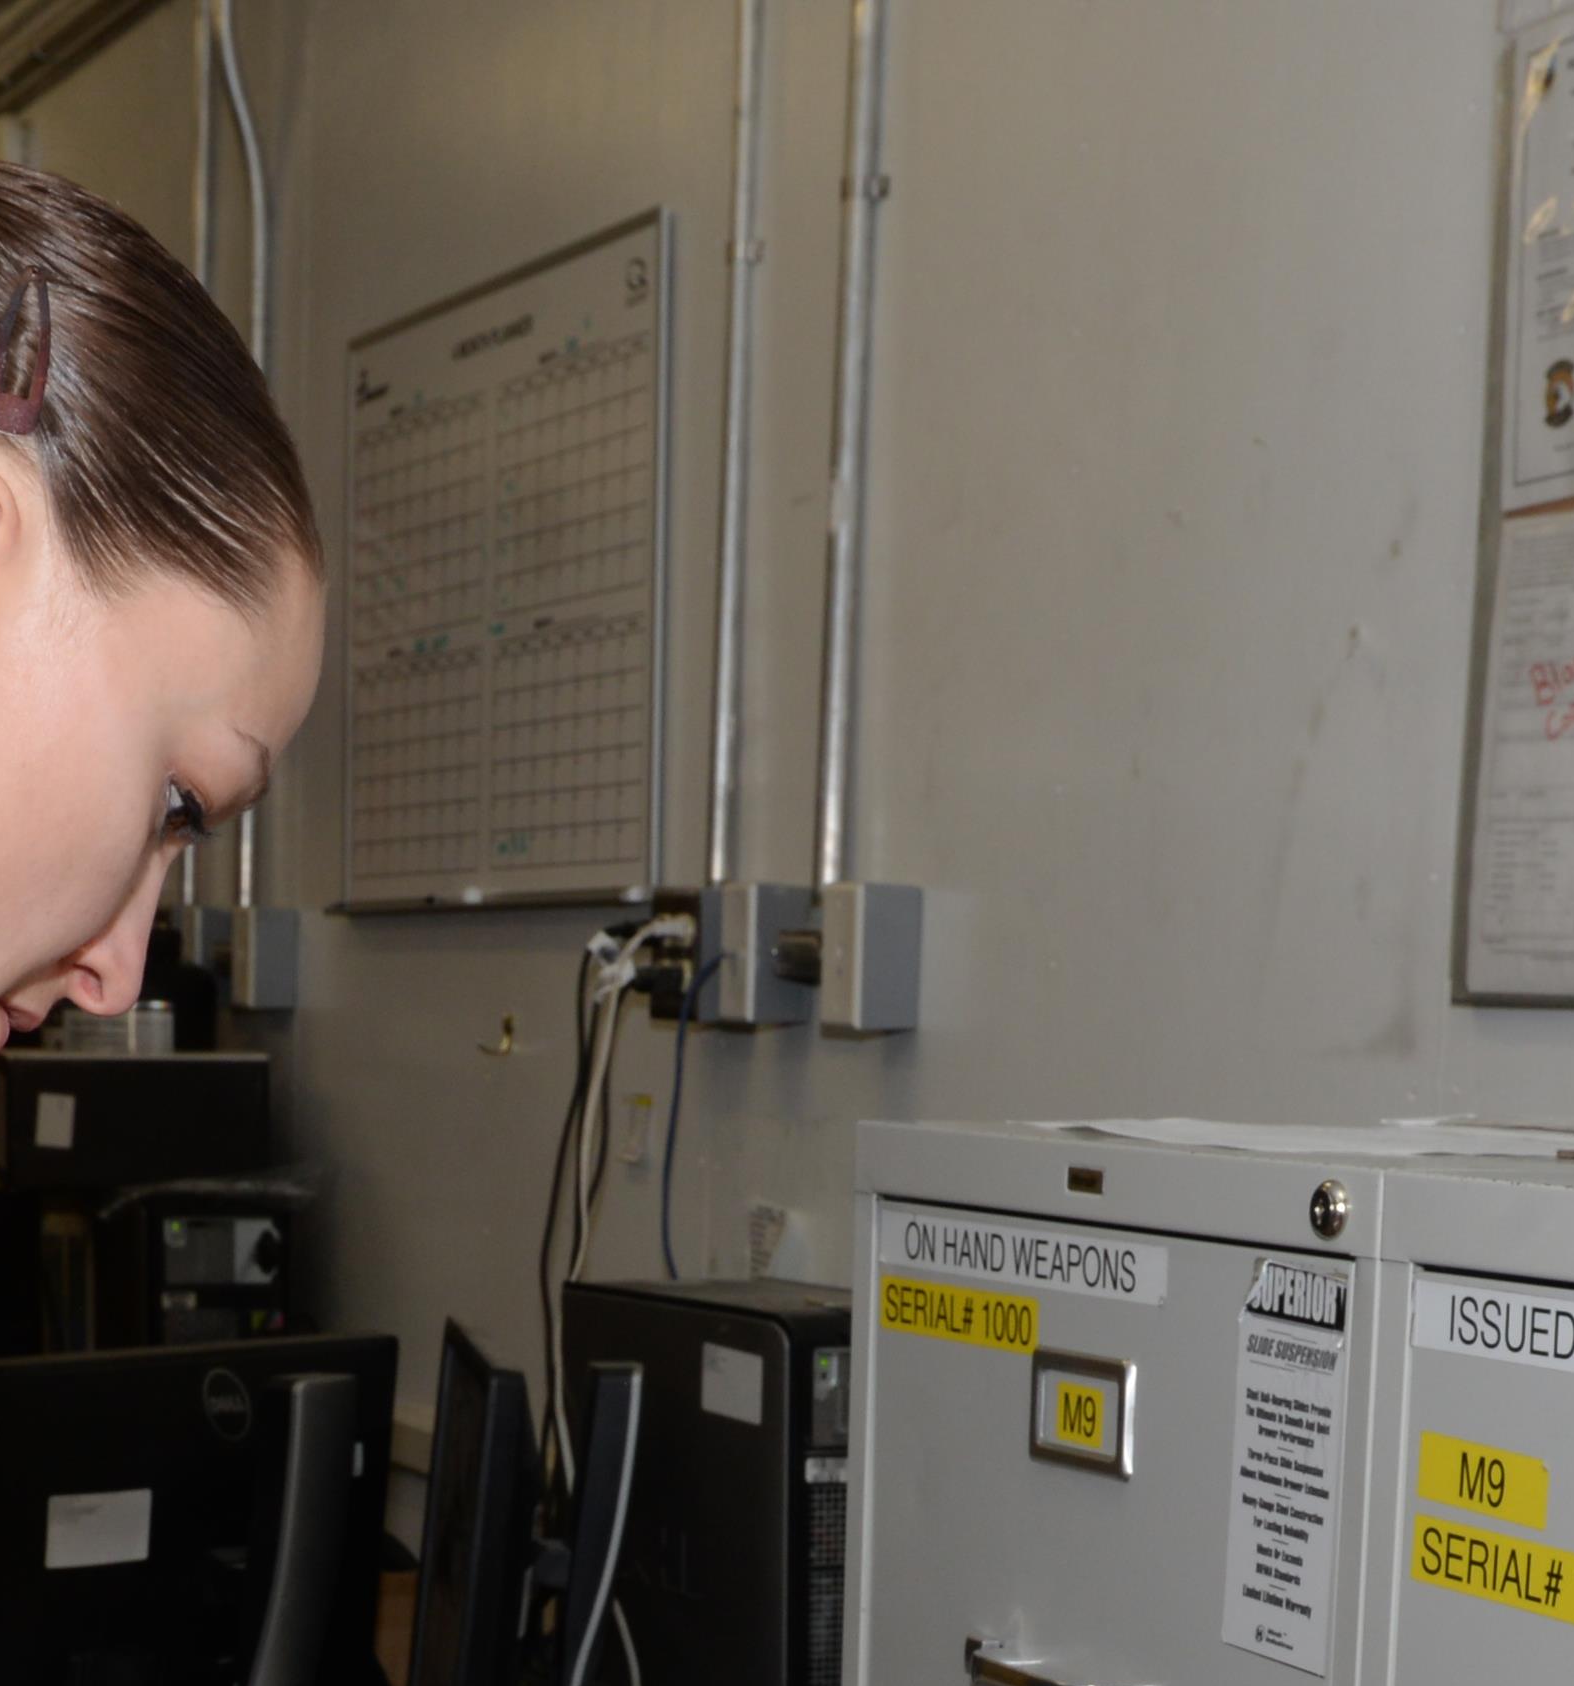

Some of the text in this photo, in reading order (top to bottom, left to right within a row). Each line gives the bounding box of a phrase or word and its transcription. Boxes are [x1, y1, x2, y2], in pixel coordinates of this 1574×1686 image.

[904, 1219, 1136, 1293] ON HAND WEAPONS
[884, 1281, 1033, 1348] SERIAL# 1000
[1247, 1334, 1339, 1371] SLIDE SUSPENSION
[1063, 1392, 1097, 1440] M9
[1459, 1452, 1506, 1507] M9
[1421, 1526, 1562, 1606] SERIAL#
